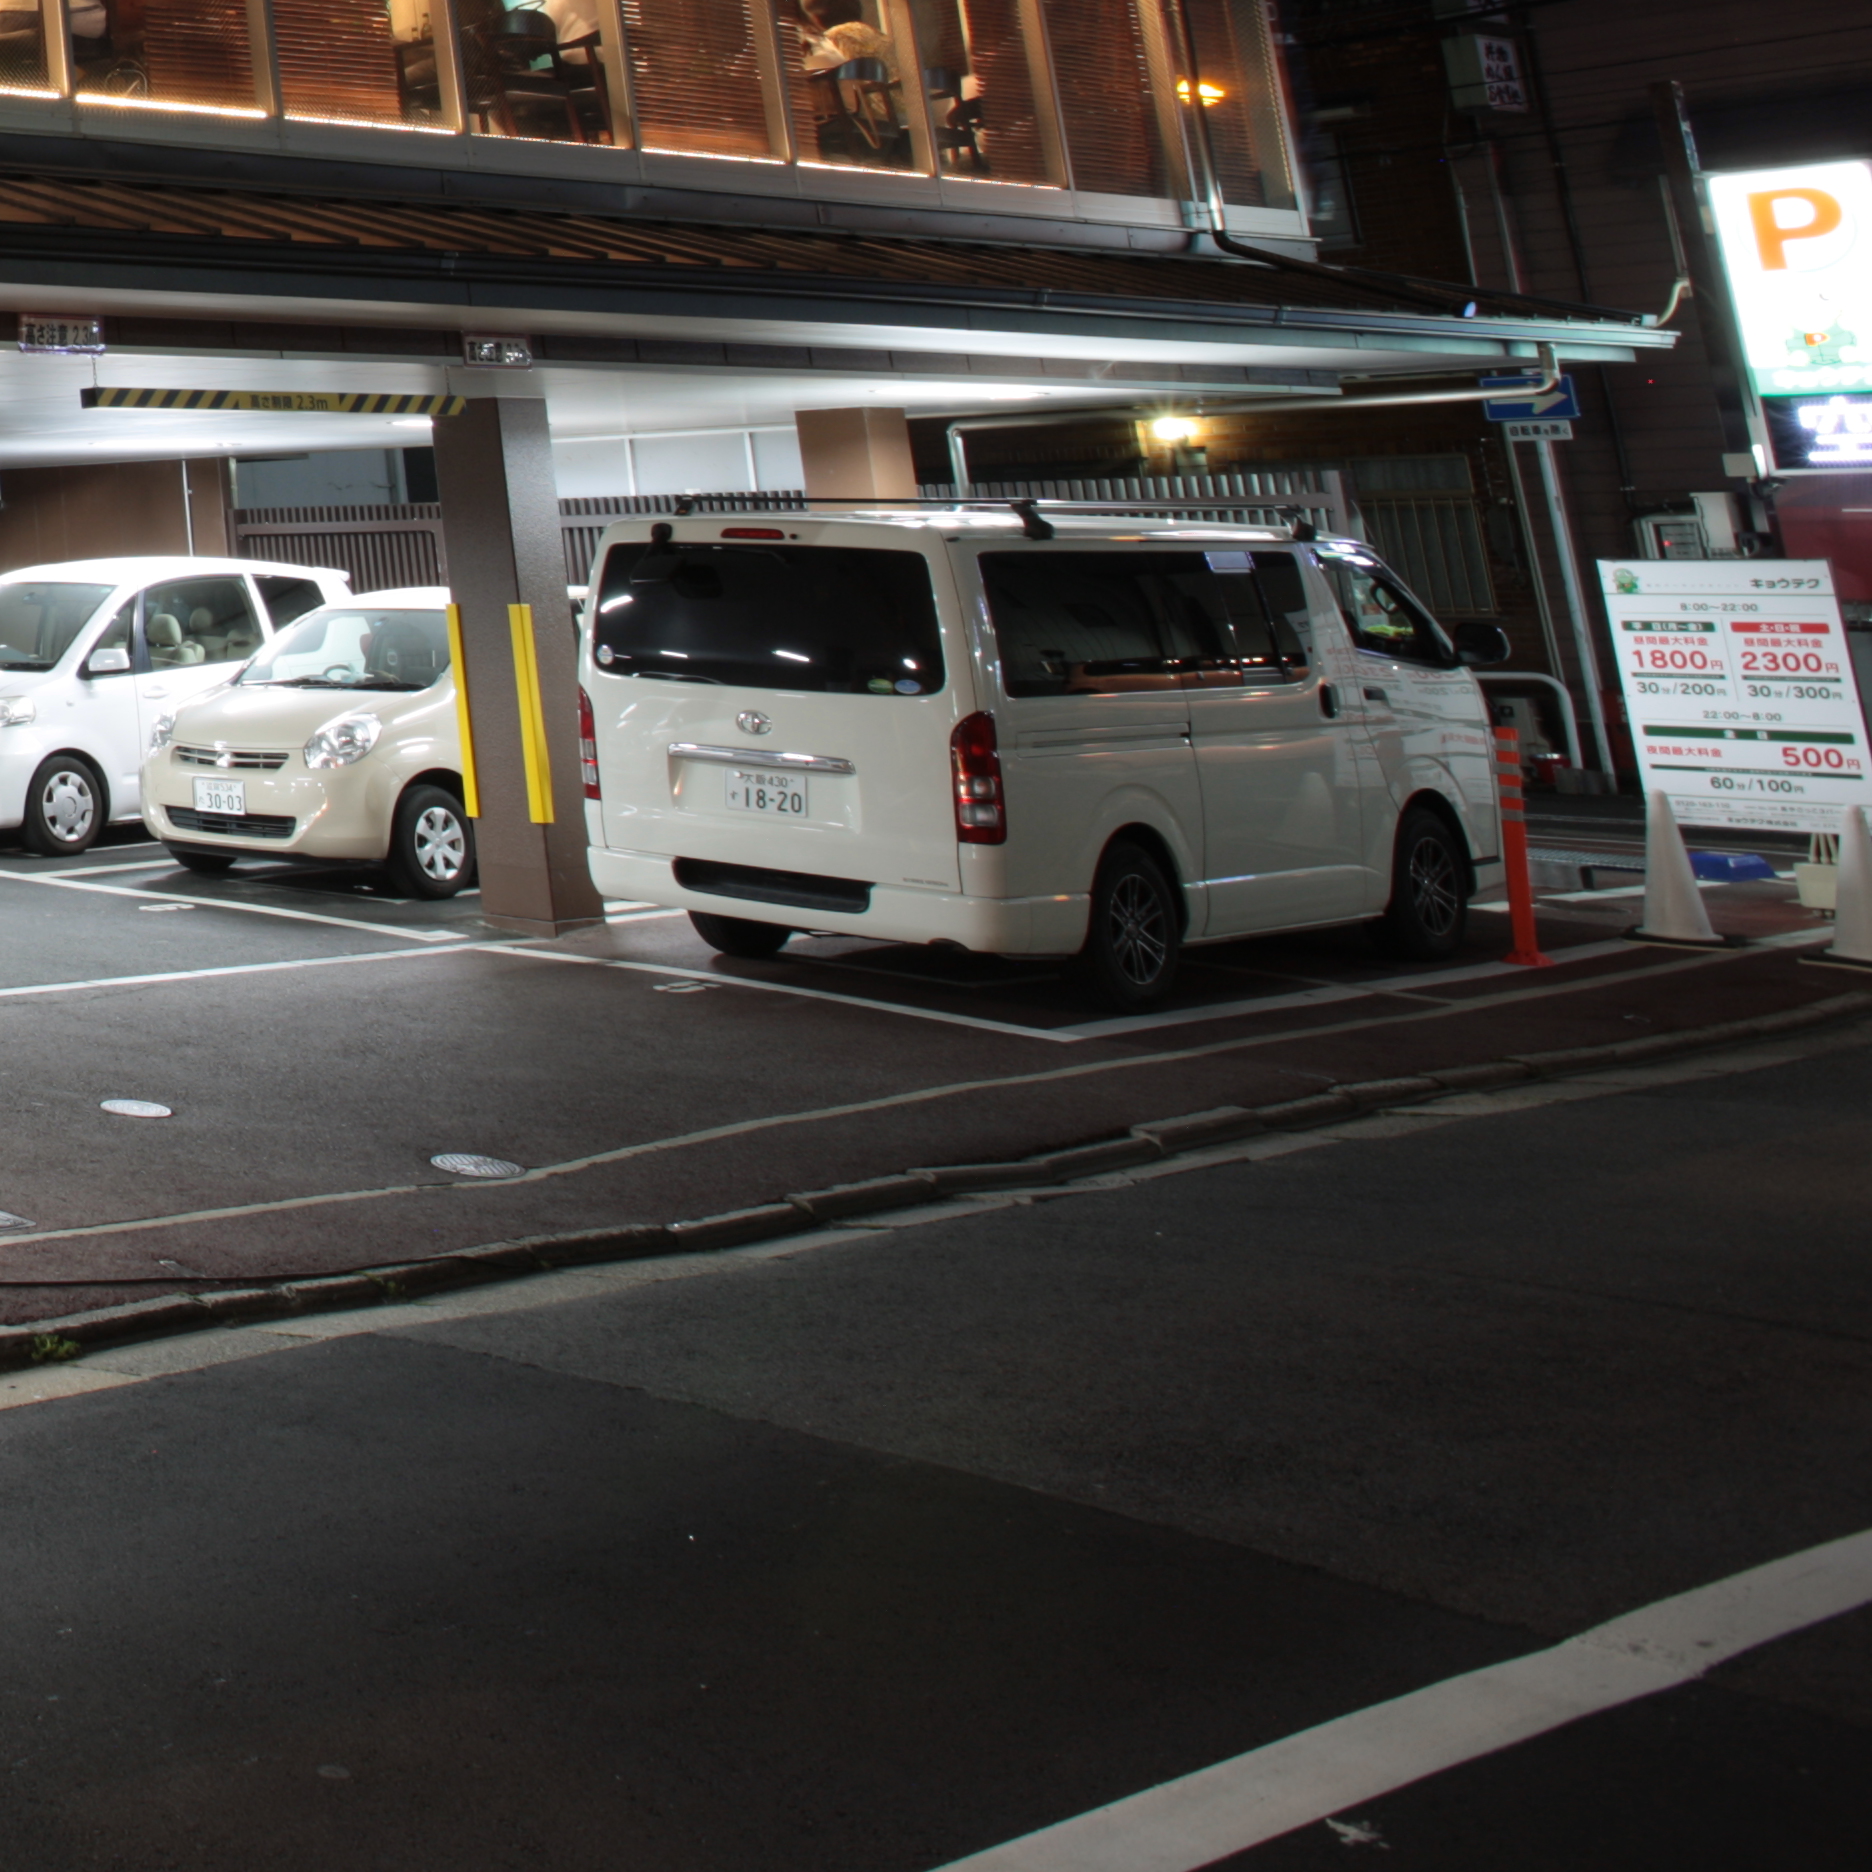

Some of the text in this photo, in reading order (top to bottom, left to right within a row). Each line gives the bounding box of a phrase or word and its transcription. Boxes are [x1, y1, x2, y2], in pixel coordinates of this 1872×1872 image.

[1746, 187, 1843, 271] P
[25, 323, 68, 346] 高さ注意
[249, 394, 328, 410] 高さ制限 2.3m
[1509, 424, 1569, 437] 自転車を除く
[1750, 578, 1821, 590] キョウテク
[1679, 602, 1758, 612] 8:00〜22:00
[1633, 636, 1709, 647] 昼間最大料金
[1743, 638, 1823, 649] 昼間最大料金
[1702, 710, 1782, 722] 22:00〜8:00
[1646, 745, 1722, 758] 夜間最大料金
[206, 792, 242, 811] 30-03
[744, 786, 802, 813] 18-20
